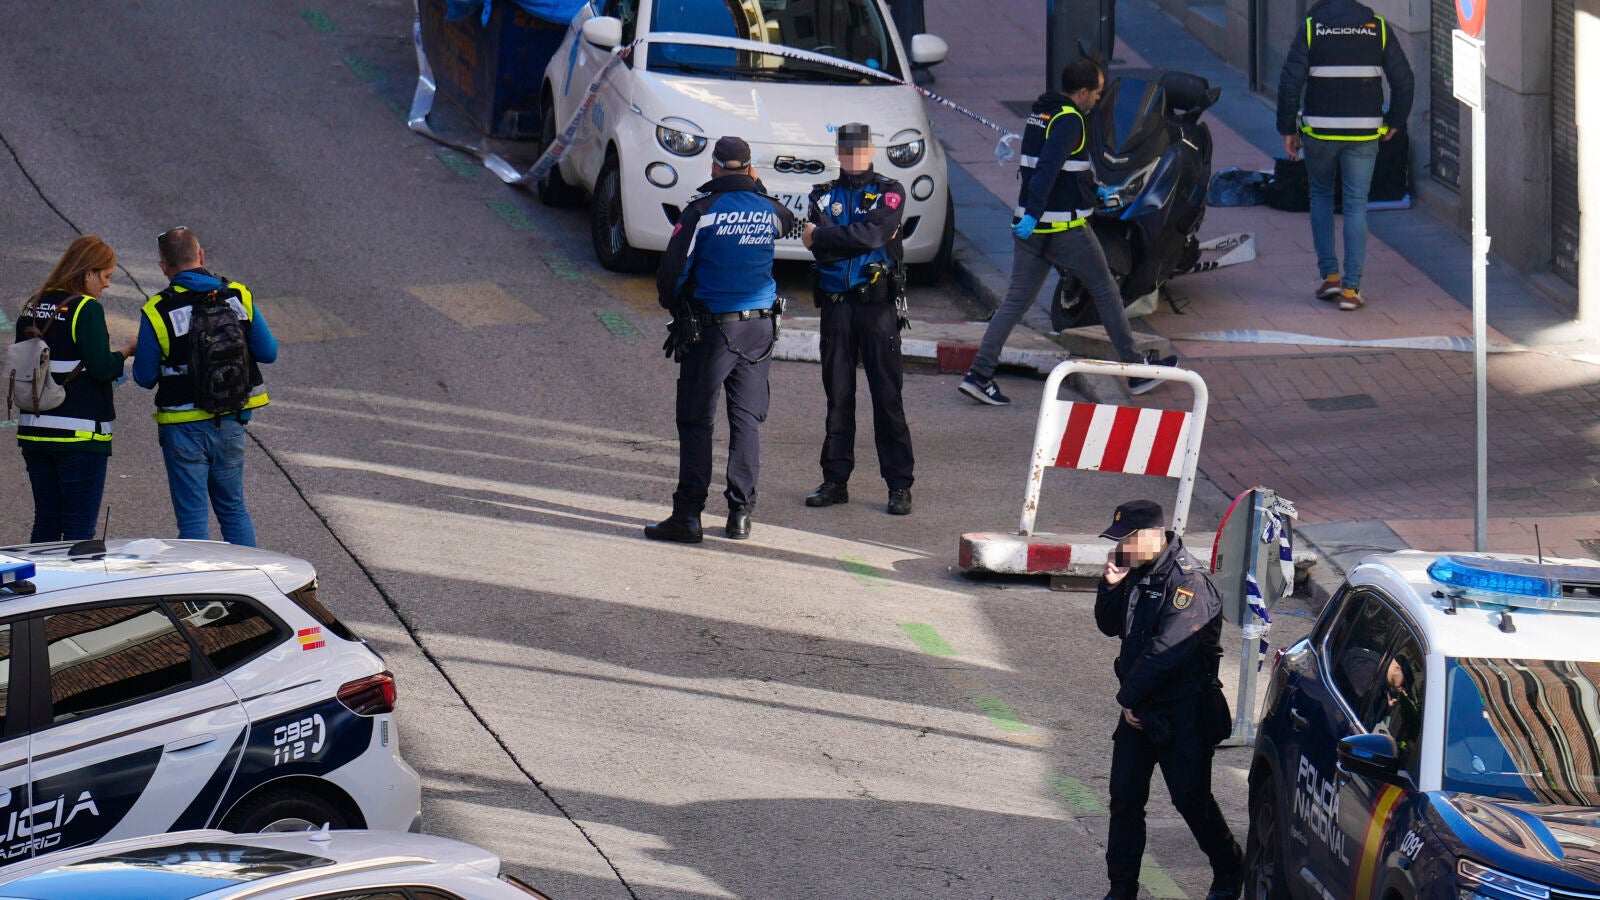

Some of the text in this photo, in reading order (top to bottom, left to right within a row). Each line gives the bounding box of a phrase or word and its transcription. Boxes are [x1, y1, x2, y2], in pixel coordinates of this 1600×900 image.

[1316, 27, 1377, 36] NACIONAL
[774, 194, 804, 212] 74
[716, 210, 772, 225] POLICÍA
[274, 717, 314, 746] 092
[273, 740, 306, 767] 112
[1293, 787, 1350, 867] NACIONAL
[0, 832, 62, 859] ADRID
